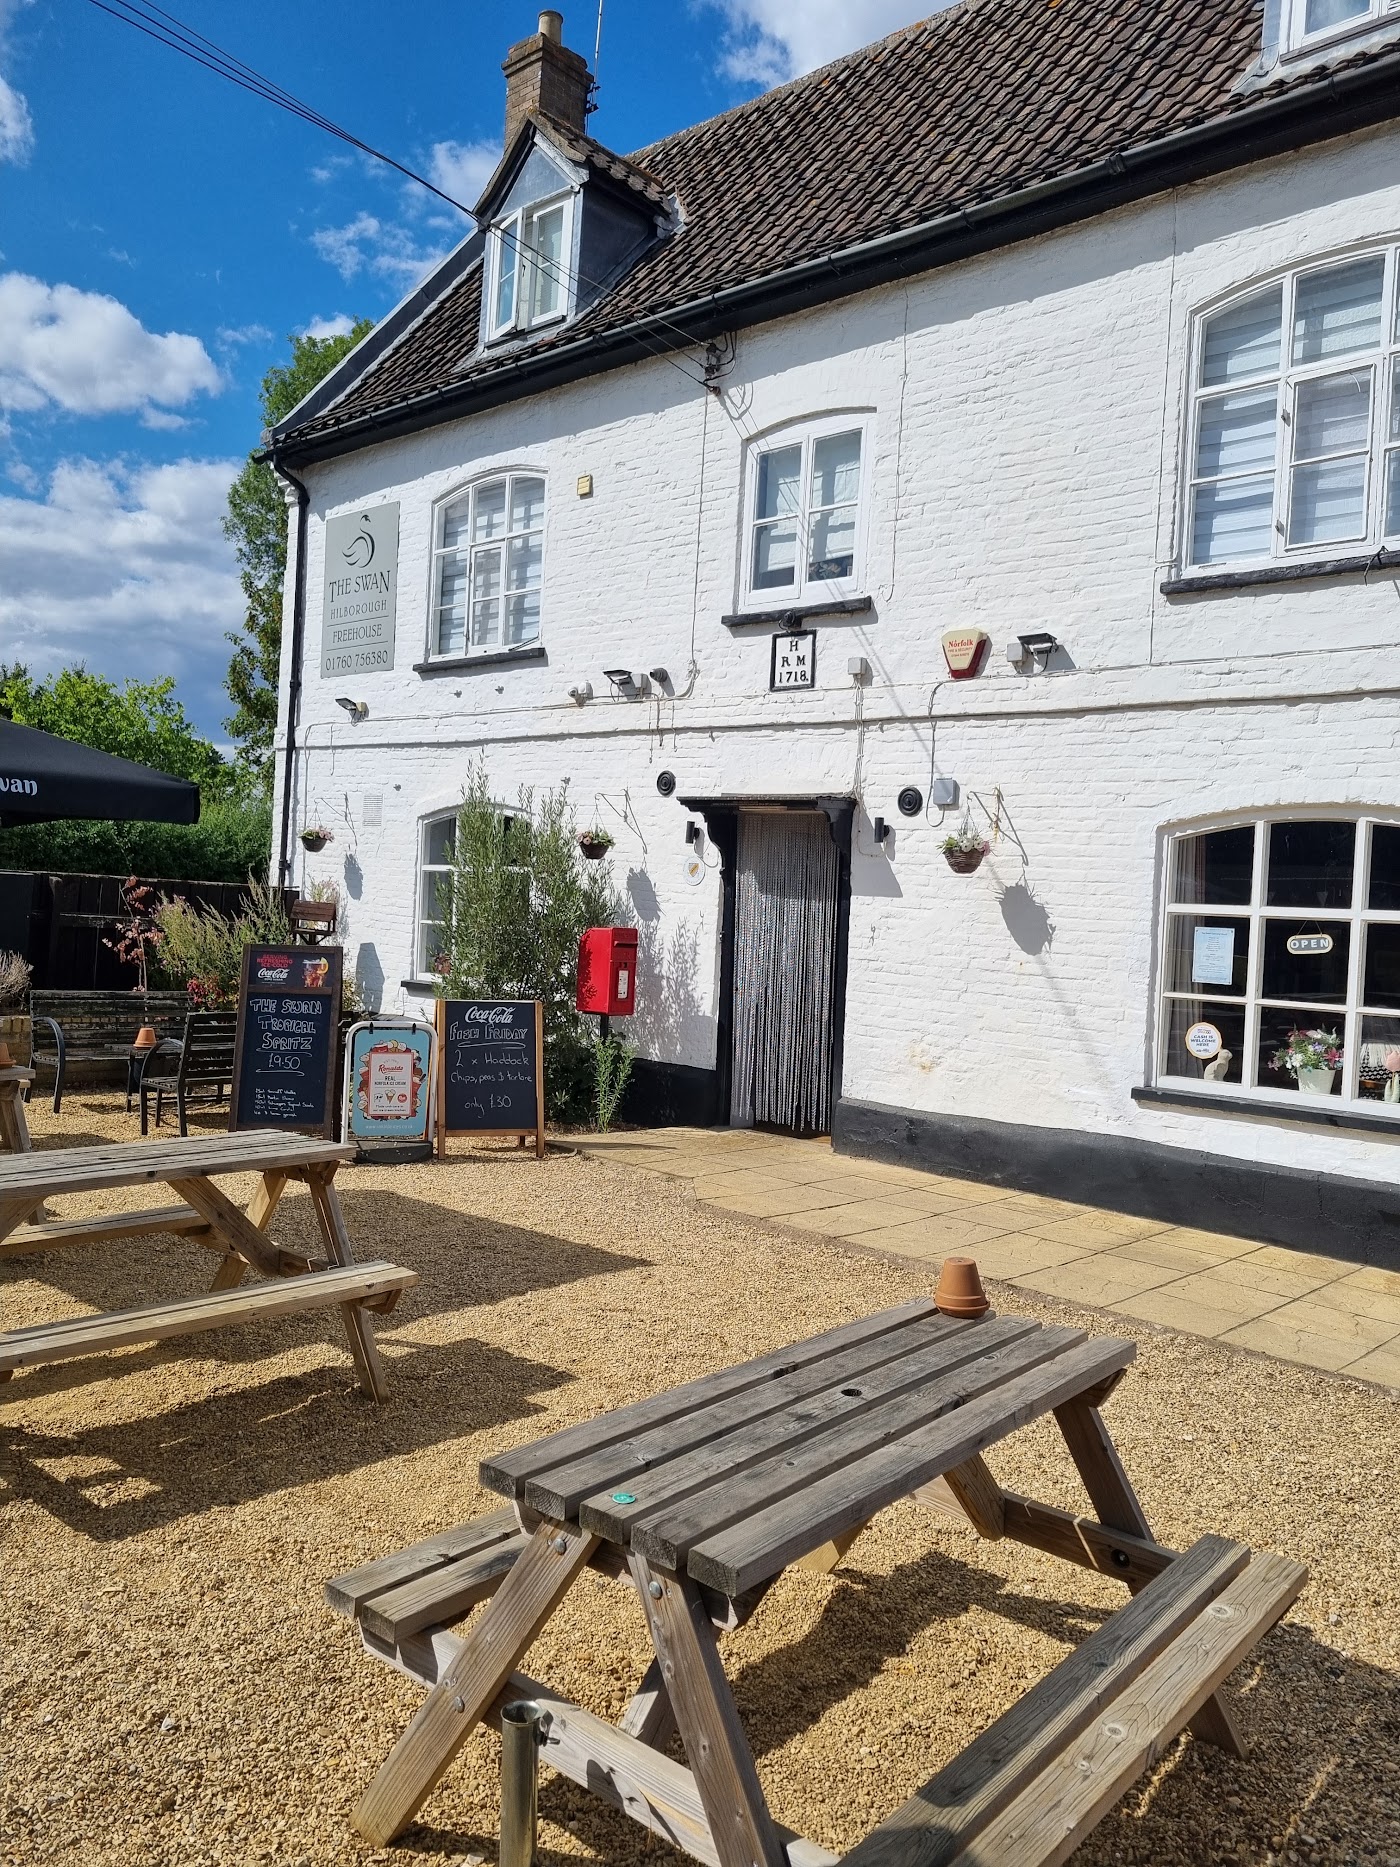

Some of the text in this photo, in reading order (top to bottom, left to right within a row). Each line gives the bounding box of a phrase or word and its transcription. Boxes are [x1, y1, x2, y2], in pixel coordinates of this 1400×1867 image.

[328, 570, 390, 603] THE SWAN
[330, 599, 387, 620] HILBOROUGH
[332, 623, 382, 643] FREEHOUSE
[789, 640, 798, 652] H
[948, 639, 974, 648] Norfolk
[325, 650, 388, 671] 01760 756380
[781, 655, 806, 668] R M
[1290, 939, 1329, 949] OPEN
[250, 999, 322, 1015] THE SWAN
[465, 1006, 516, 1024] Coca-Cola
[450, 1021, 528, 1040] FISH FRIDAY
[262, 1032, 313, 1050] SPRITZ
[269, 1053, 301, 1070] £9.50
[455, 1049, 464, 1067] 2
[485, 1051, 529, 1066] Haddock
[480, 1075, 496, 1084] peas
[465, 1094, 512, 1118] only £30
